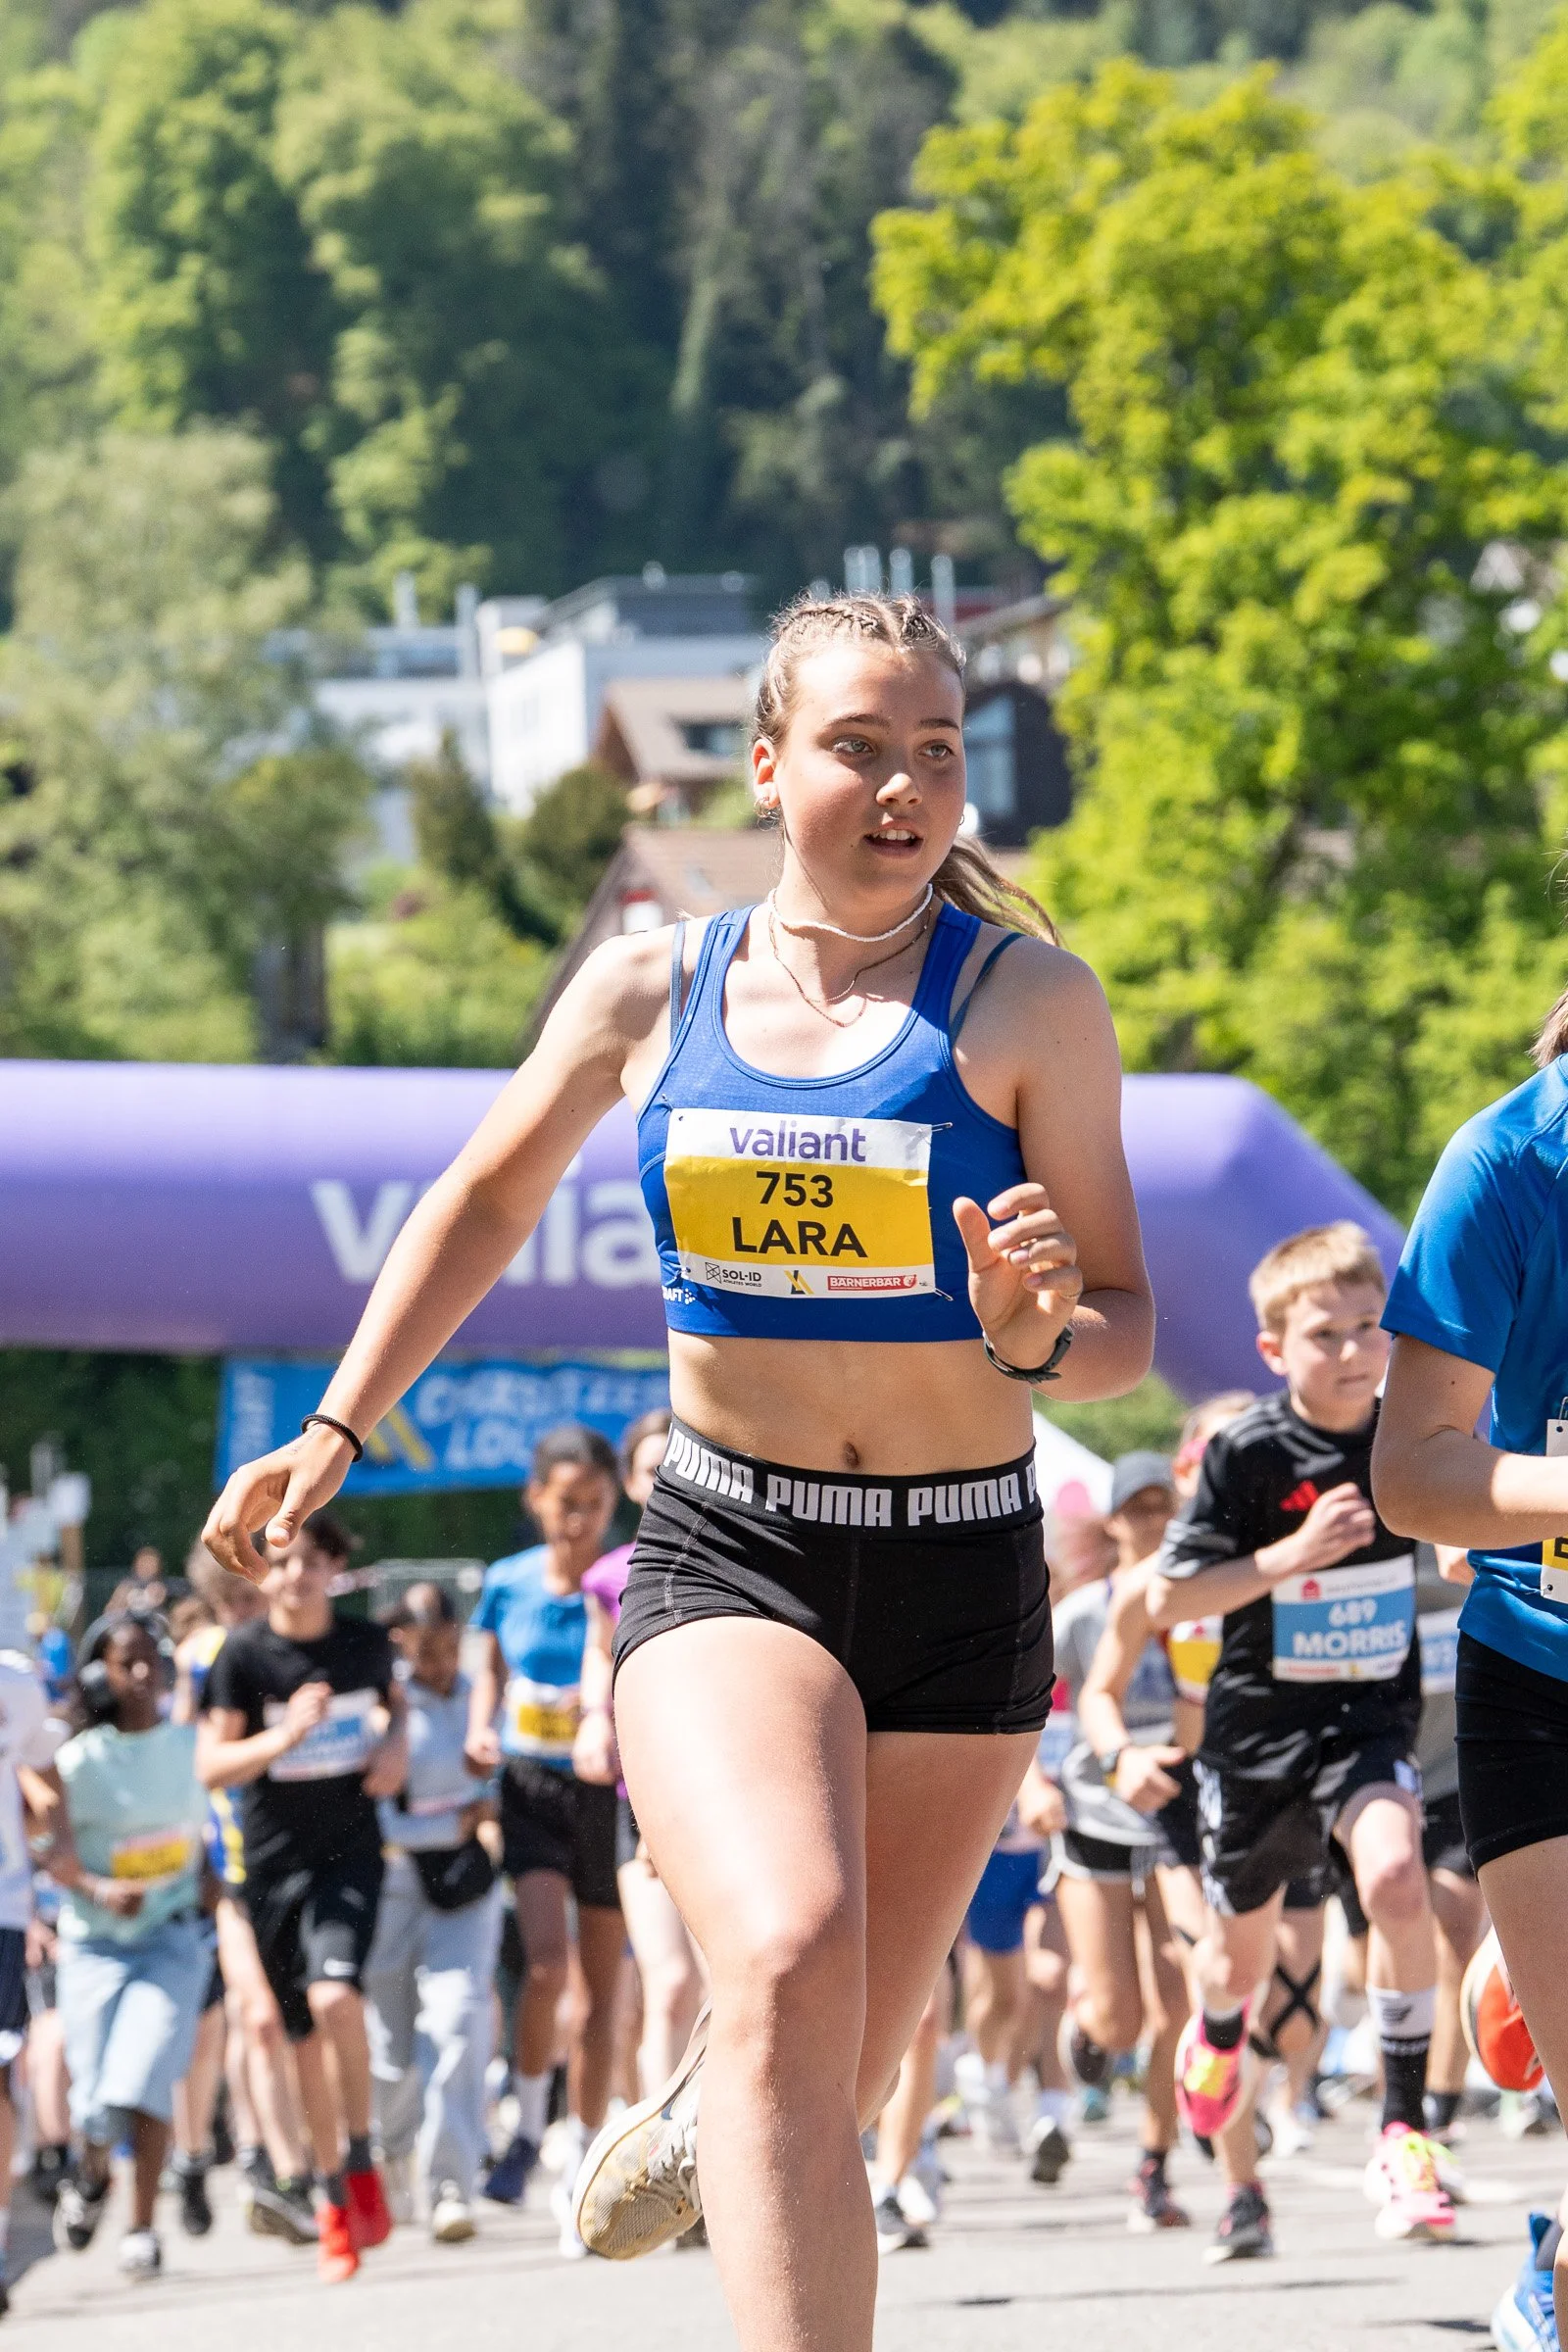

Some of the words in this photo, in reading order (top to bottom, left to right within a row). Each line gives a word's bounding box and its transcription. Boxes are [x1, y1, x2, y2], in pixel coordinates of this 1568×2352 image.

[729, 1120, 866, 1162] valiant
[756, 1171, 834, 1208] 753
[732, 1216, 868, 1258] LARA
[722, 1269, 761, 1282] SOL-ID
[830, 1276, 902, 1289] BÄRNERBÄR
[662, 1428, 754, 1504] PUMA
[765, 1474, 893, 1527] PUMA
[907, 1472, 1023, 1527] PUMA
[1329, 1598, 1378, 1627] 689
[1293, 1619, 1407, 1657] MORRIS
